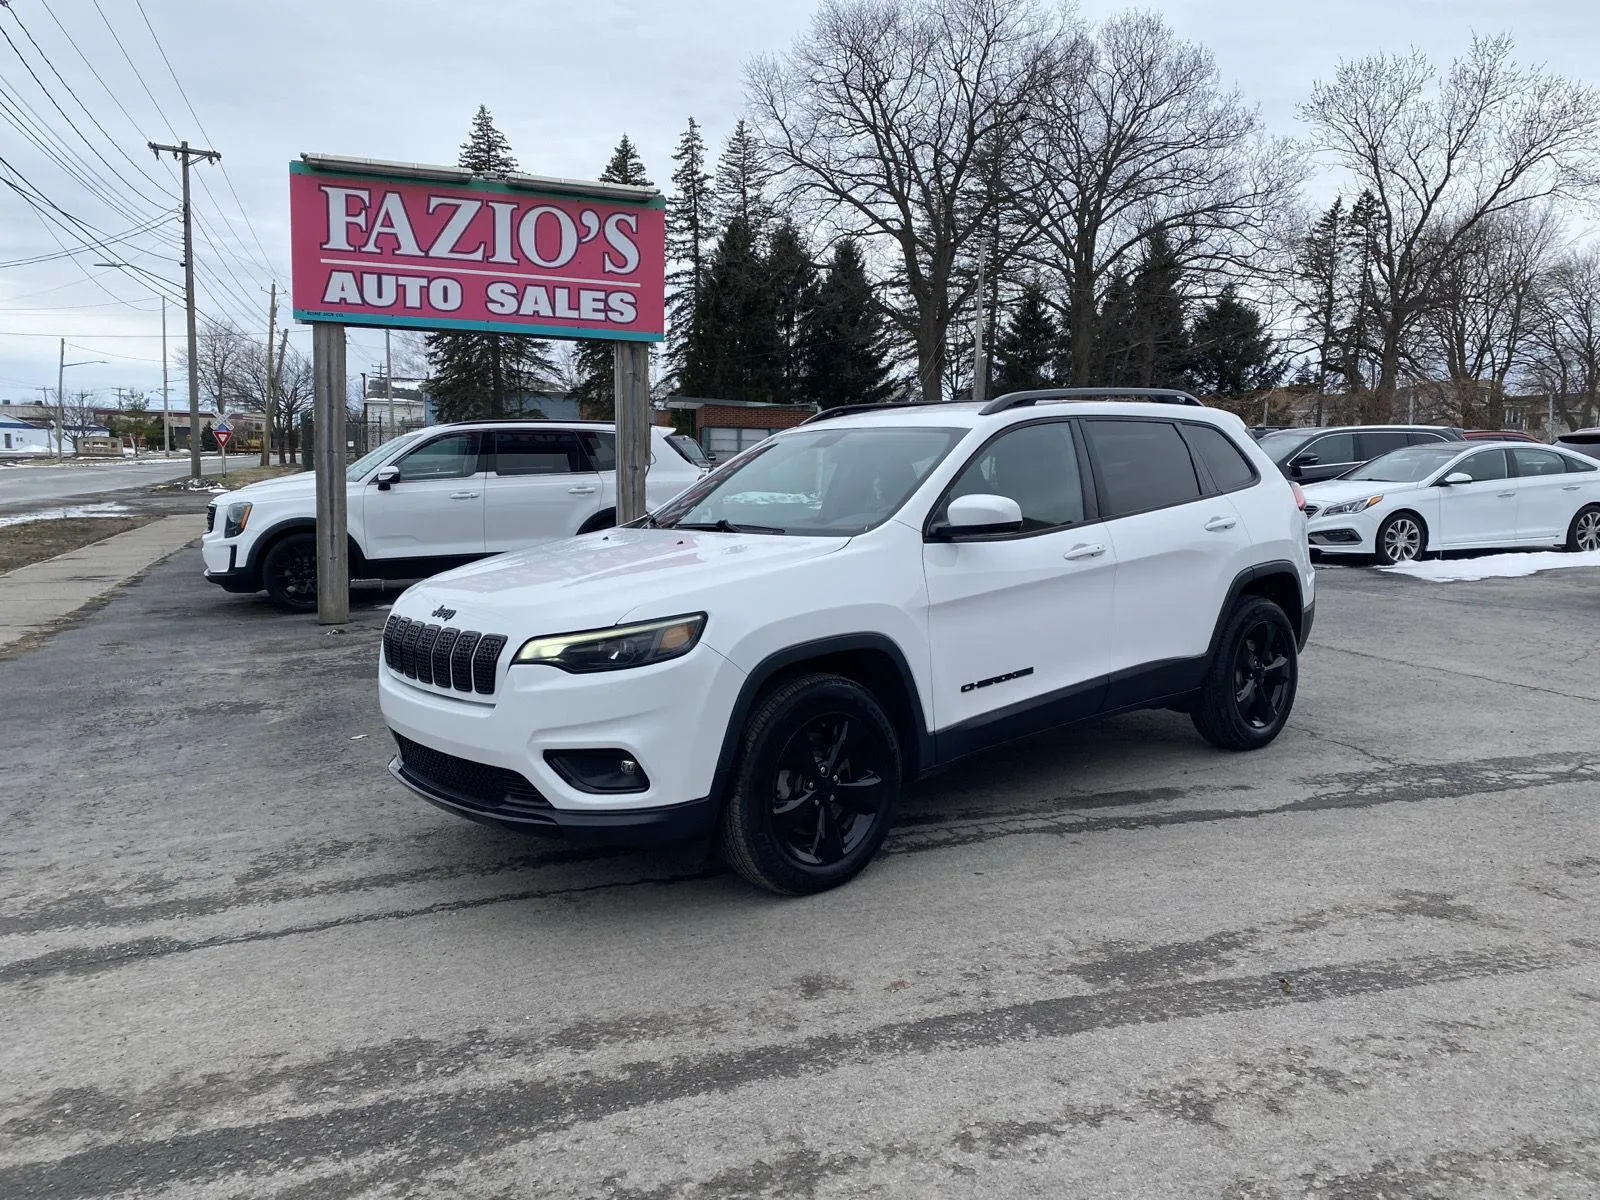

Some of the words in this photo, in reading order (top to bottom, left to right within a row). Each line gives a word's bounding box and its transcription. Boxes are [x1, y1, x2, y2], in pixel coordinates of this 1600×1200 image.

[319, 184, 641, 275] FAZIO'S
[322, 269, 464, 312] AUTO
[485, 280, 638, 325] SALES
[432, 604, 457, 622] Jeep
[960, 666, 1034, 693] CHEROKEE
